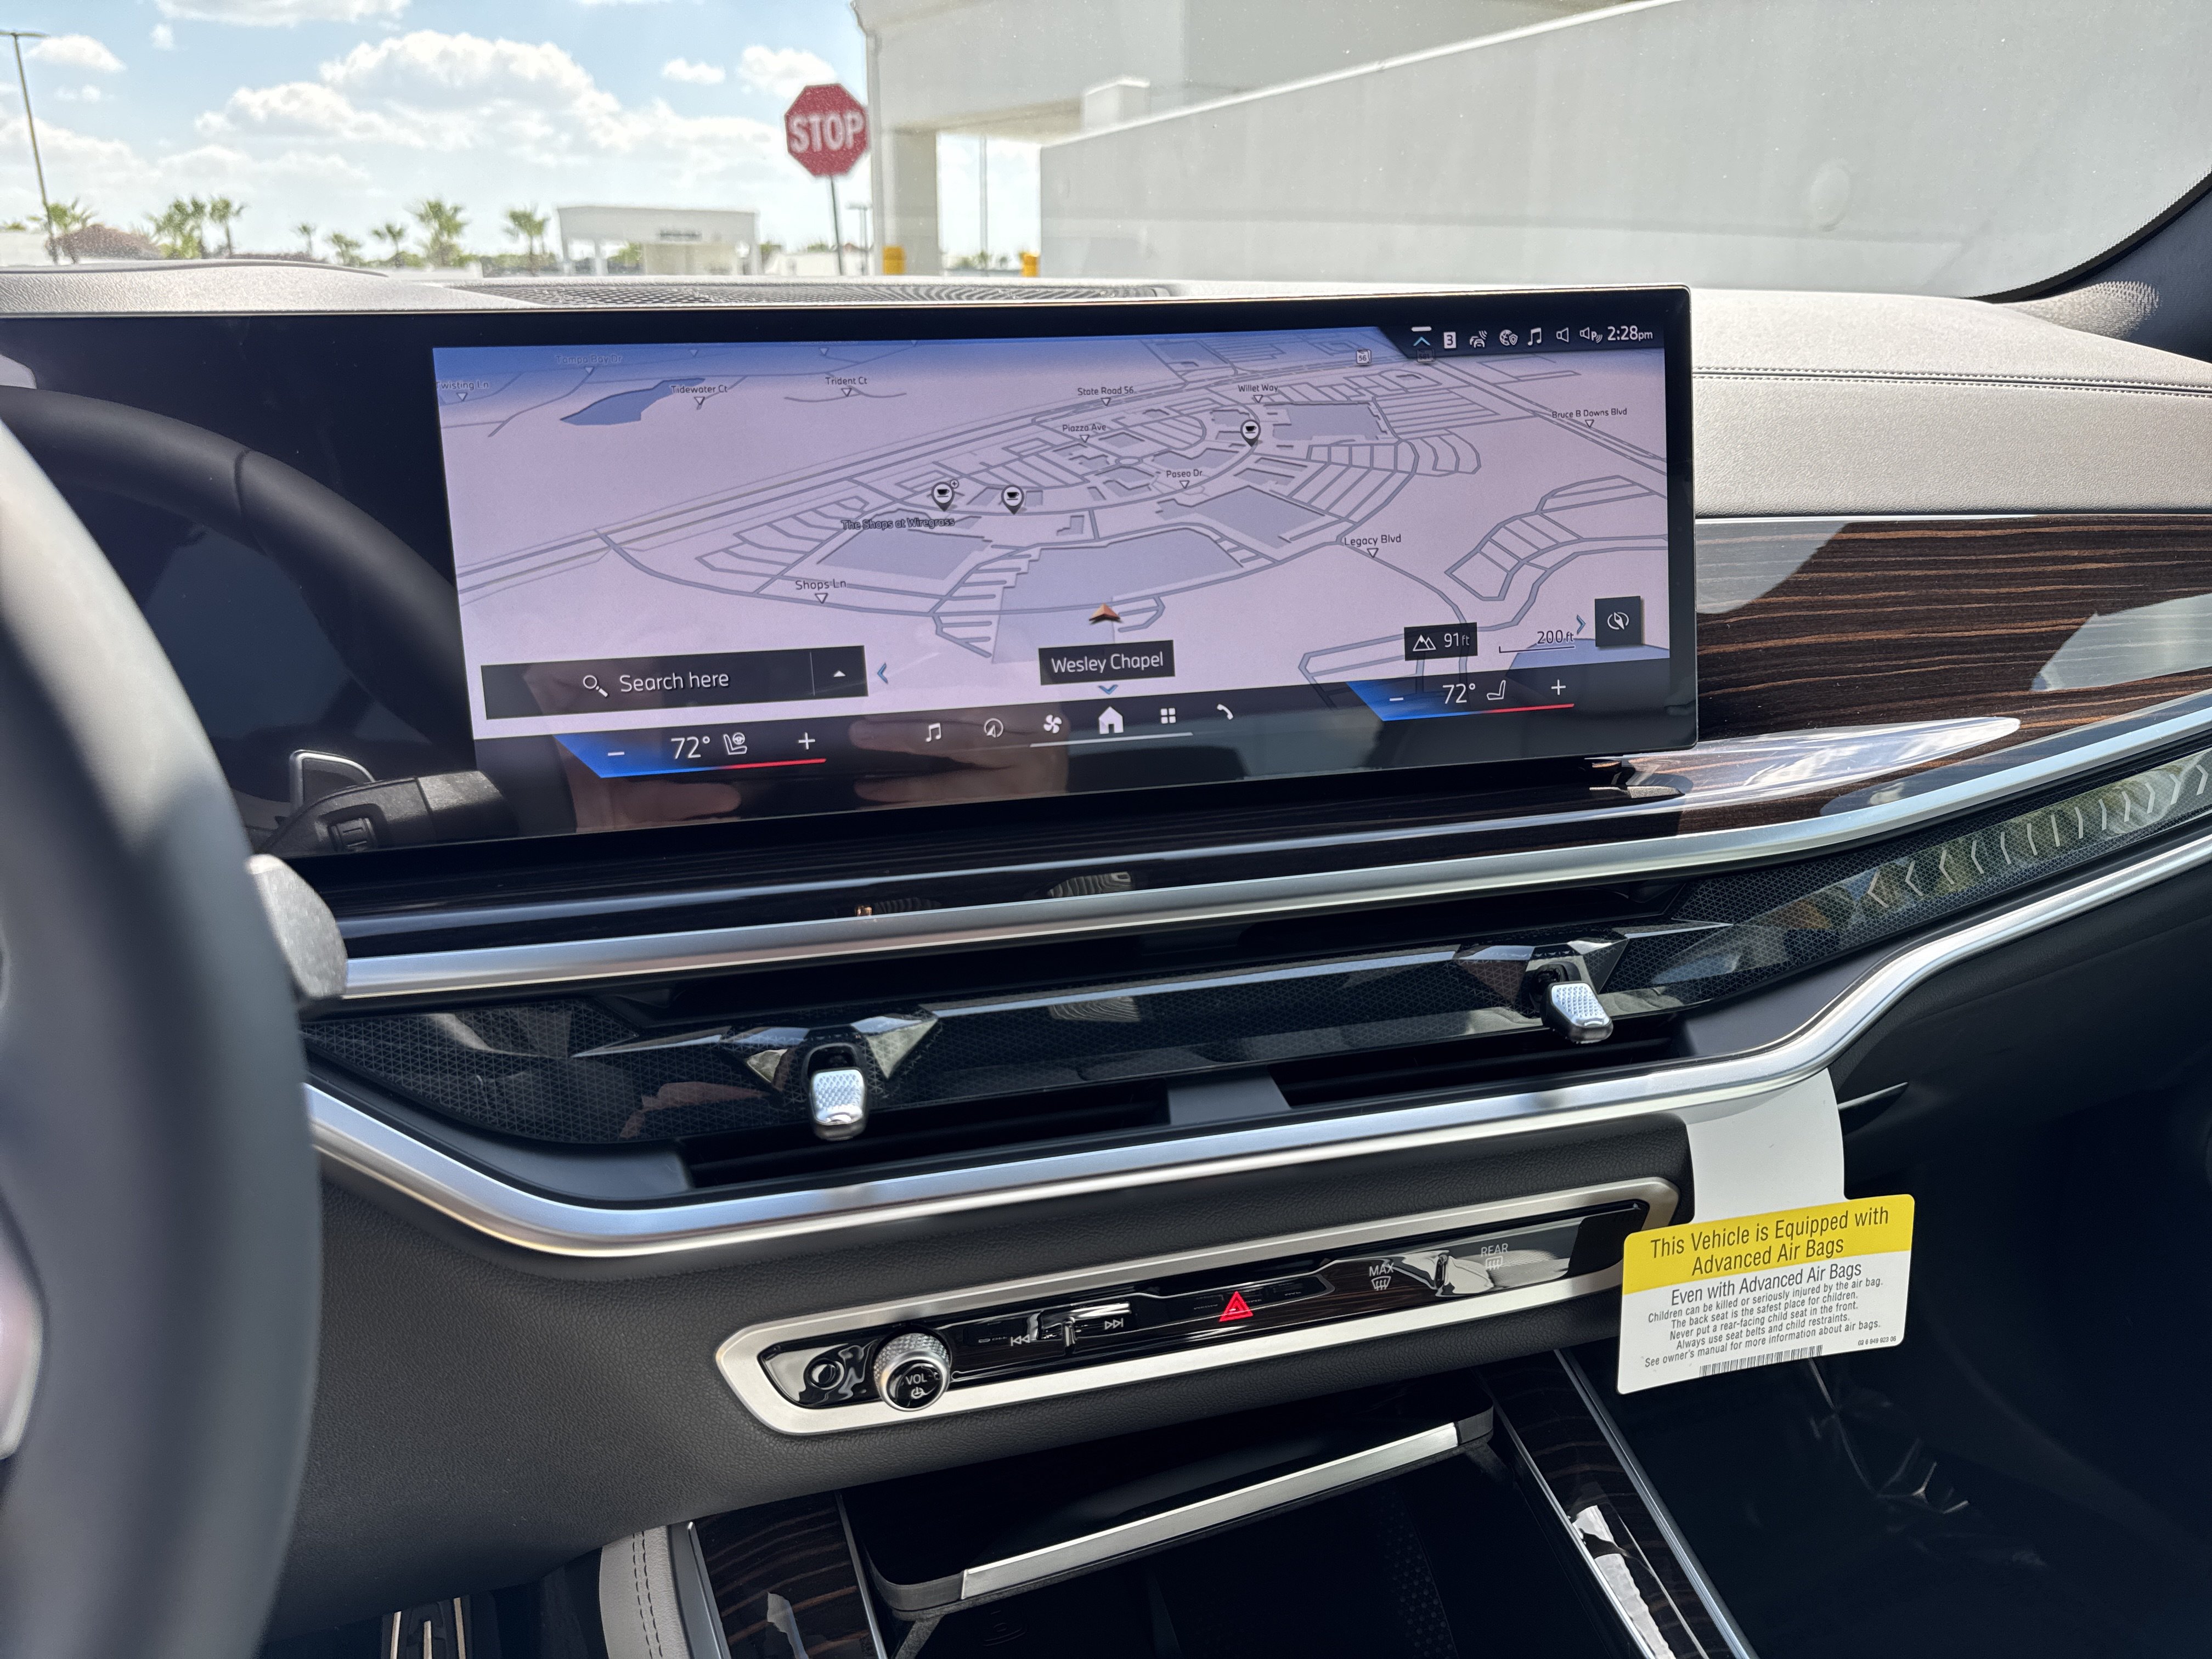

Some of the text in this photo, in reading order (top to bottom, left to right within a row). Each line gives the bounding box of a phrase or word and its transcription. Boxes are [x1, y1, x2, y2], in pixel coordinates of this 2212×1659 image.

[788, 110, 864, 154] STOP
[1447, 334, 1454, 346] 3
[1607, 325, 1653, 341] 2:28pm
[556, 354, 622, 366] Tampa Bay Dr
[436, 380, 489, 391] Twisting Ln
[826, 376, 868, 386] Trident Ct
[671, 385, 728, 394] Tidewater Ct
[1077, 386, 1134, 396] State Road 56
[1238, 383, 1278, 394] Willet Way
[1552, 411, 1572, 419] Bruce
[1583, 409, 1609, 417] Downs
[1612, 408, 1627, 416] Blvd
[1062, 424, 1107, 433] Piazza Ave
[1166, 469, 1203, 479] Paseo Dr
[841, 517, 955, 531] The Shops at Wiregrass
[1344, 534, 1402, 548] Legacy Blvd
[795, 579, 847, 592] Shops Ln
[1051, 651, 1163, 674] Wesley Chapel
[619, 670, 730, 692] Search here
[1443, 683, 1475, 704] 72°
[671, 736, 710, 759] 72°
[1651, 1206, 1888, 1258] This Vehicle is Equipped with
[1481, 1243, 1509, 1256] REAR
[1691, 1239, 1844, 1276] Advanced Air Bags
[1369, 1262, 1394, 1276] MAX
[1671, 1263, 1861, 1306] Even with Advanced Air Bags
[1648, 1277, 1883, 1323] Children can be killed or seriously injured by the air bag.
[1672, 1290, 1858, 1329] The back seat is the safest place for children.
[1670, 1329, 1694, 1340] Never
[1696, 1324, 1710, 1337] put
[1720, 1316, 1765, 1331] rear-facing
[1768, 1310, 1787, 1322] child
[1791, 1307, 1807, 1319] seat
[1810, 1306, 1817, 1316] in
[1820, 1304, 1833, 1314] the
[1836, 1301, 1859, 1313] front.
[1677, 1313, 1850, 1350] Always use seat belts and child restraints.
[1645, 1320, 1881, 1368] See owner's manual for more information about air bags.
[906, 1373, 928, 1385] VOL
